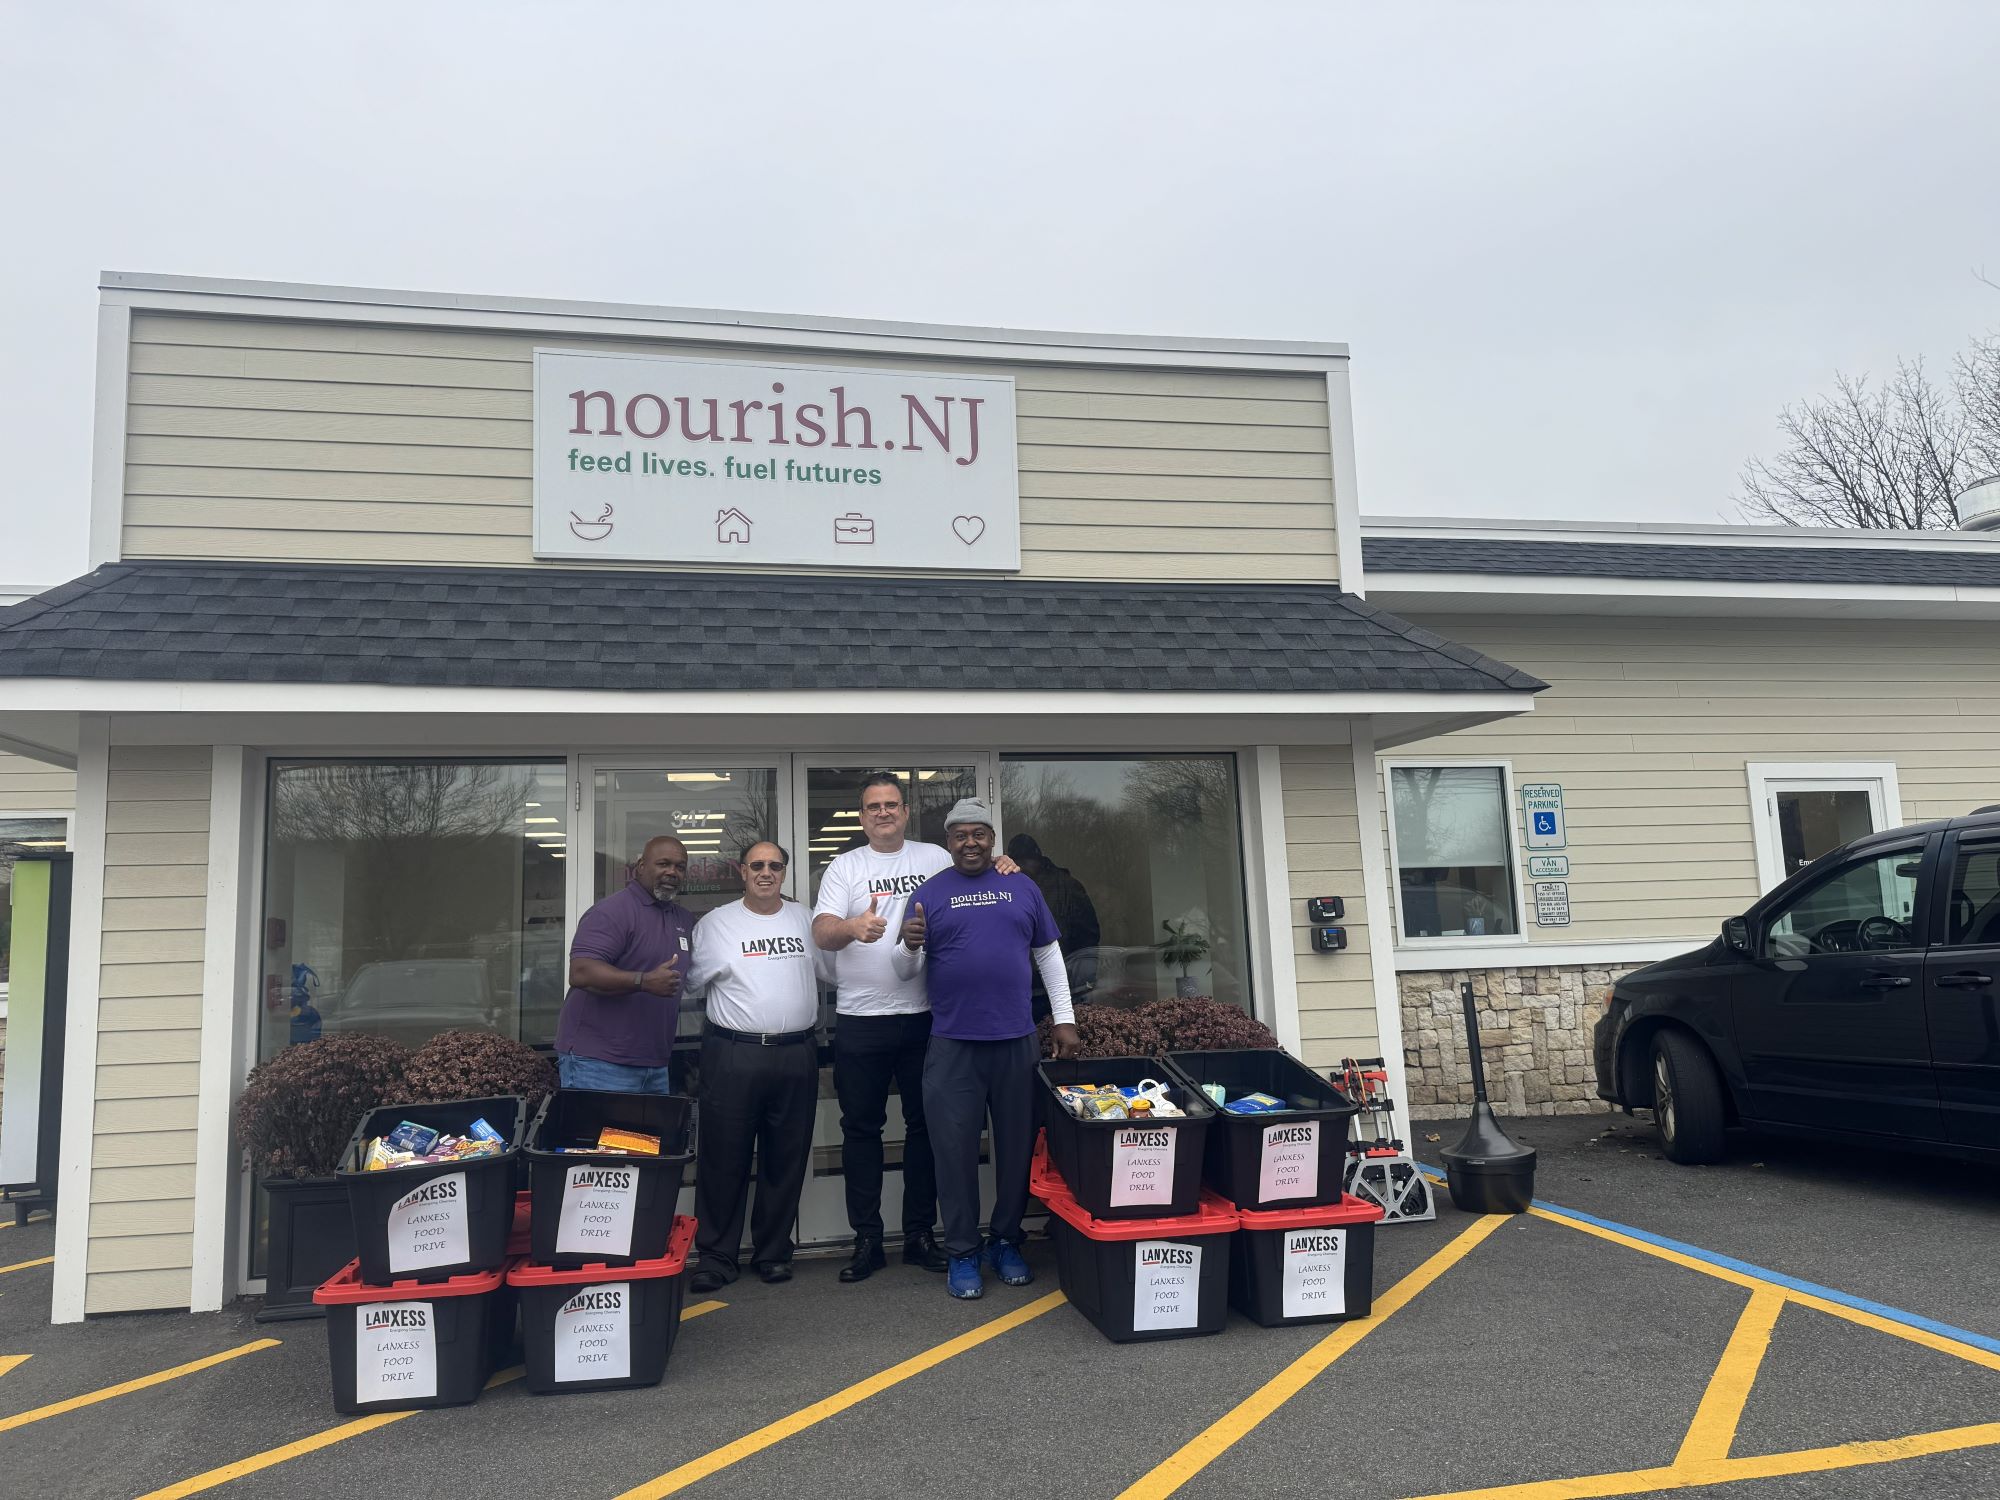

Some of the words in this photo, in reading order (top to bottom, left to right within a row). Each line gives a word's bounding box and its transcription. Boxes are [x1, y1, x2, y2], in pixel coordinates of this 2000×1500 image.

[568, 382, 985, 466] nourish.NJ
[567, 449, 632, 473] feed
[642, 452, 715, 477] lives.
[725, 456, 776, 480] fuel
[785, 459, 882, 485] futures
[1524, 789, 1560, 798] RESERVED
[1528, 800, 1559, 810] PARKING
[670, 809, 711, 828] 347
[950, 891, 1012, 904] nourish.NJ
[741, 937, 805, 956] LANXESS
[1120, 1132, 1169, 1147] LANXESS
[1268, 1127, 1312, 1144] LANXESS
[1273, 1153, 1305, 1163] LANXESS
[1277, 1166, 1300, 1175] FOOD
[573, 1171, 631, 1189] LANXESS
[1275, 1178, 1300, 1186] DRIVE
[398, 1181, 457, 1209] LANXESS
[579, 1201, 619, 1210] LANXESS
[408, 1212, 450, 1224] LANXESS
[584, 1215, 612, 1223] FOOD
[414, 1227, 445, 1239] FOOD
[580, 1229, 612, 1237] DRIVE
[414, 1241, 446, 1253] DRIVE
[1290, 1236, 1339, 1252] LANXESS
[1142, 1248, 1193, 1264] LANXESS
[1299, 1264, 1331, 1274] LANXESS
[1150, 1277, 1185, 1285] LANXESS
[1303, 1278, 1326, 1287] FOOD
[1155, 1291, 1180, 1300] FOOD
[1302, 1291, 1327, 1300] DRIVE
[564, 1292, 621, 1311] LANXESS
[1153, 1305, 1180, 1313] DRIVE
[366, 1310, 426, 1327] LANXESS
[573, 1324, 614, 1334] LANXESS
[377, 1341, 420, 1352] LANXESS
[579, 1339, 608, 1349] FOOD
[384, 1357, 414, 1367] FOOD
[577, 1354, 608, 1363] DRIVE
[382, 1372, 415, 1382] DRIVE
